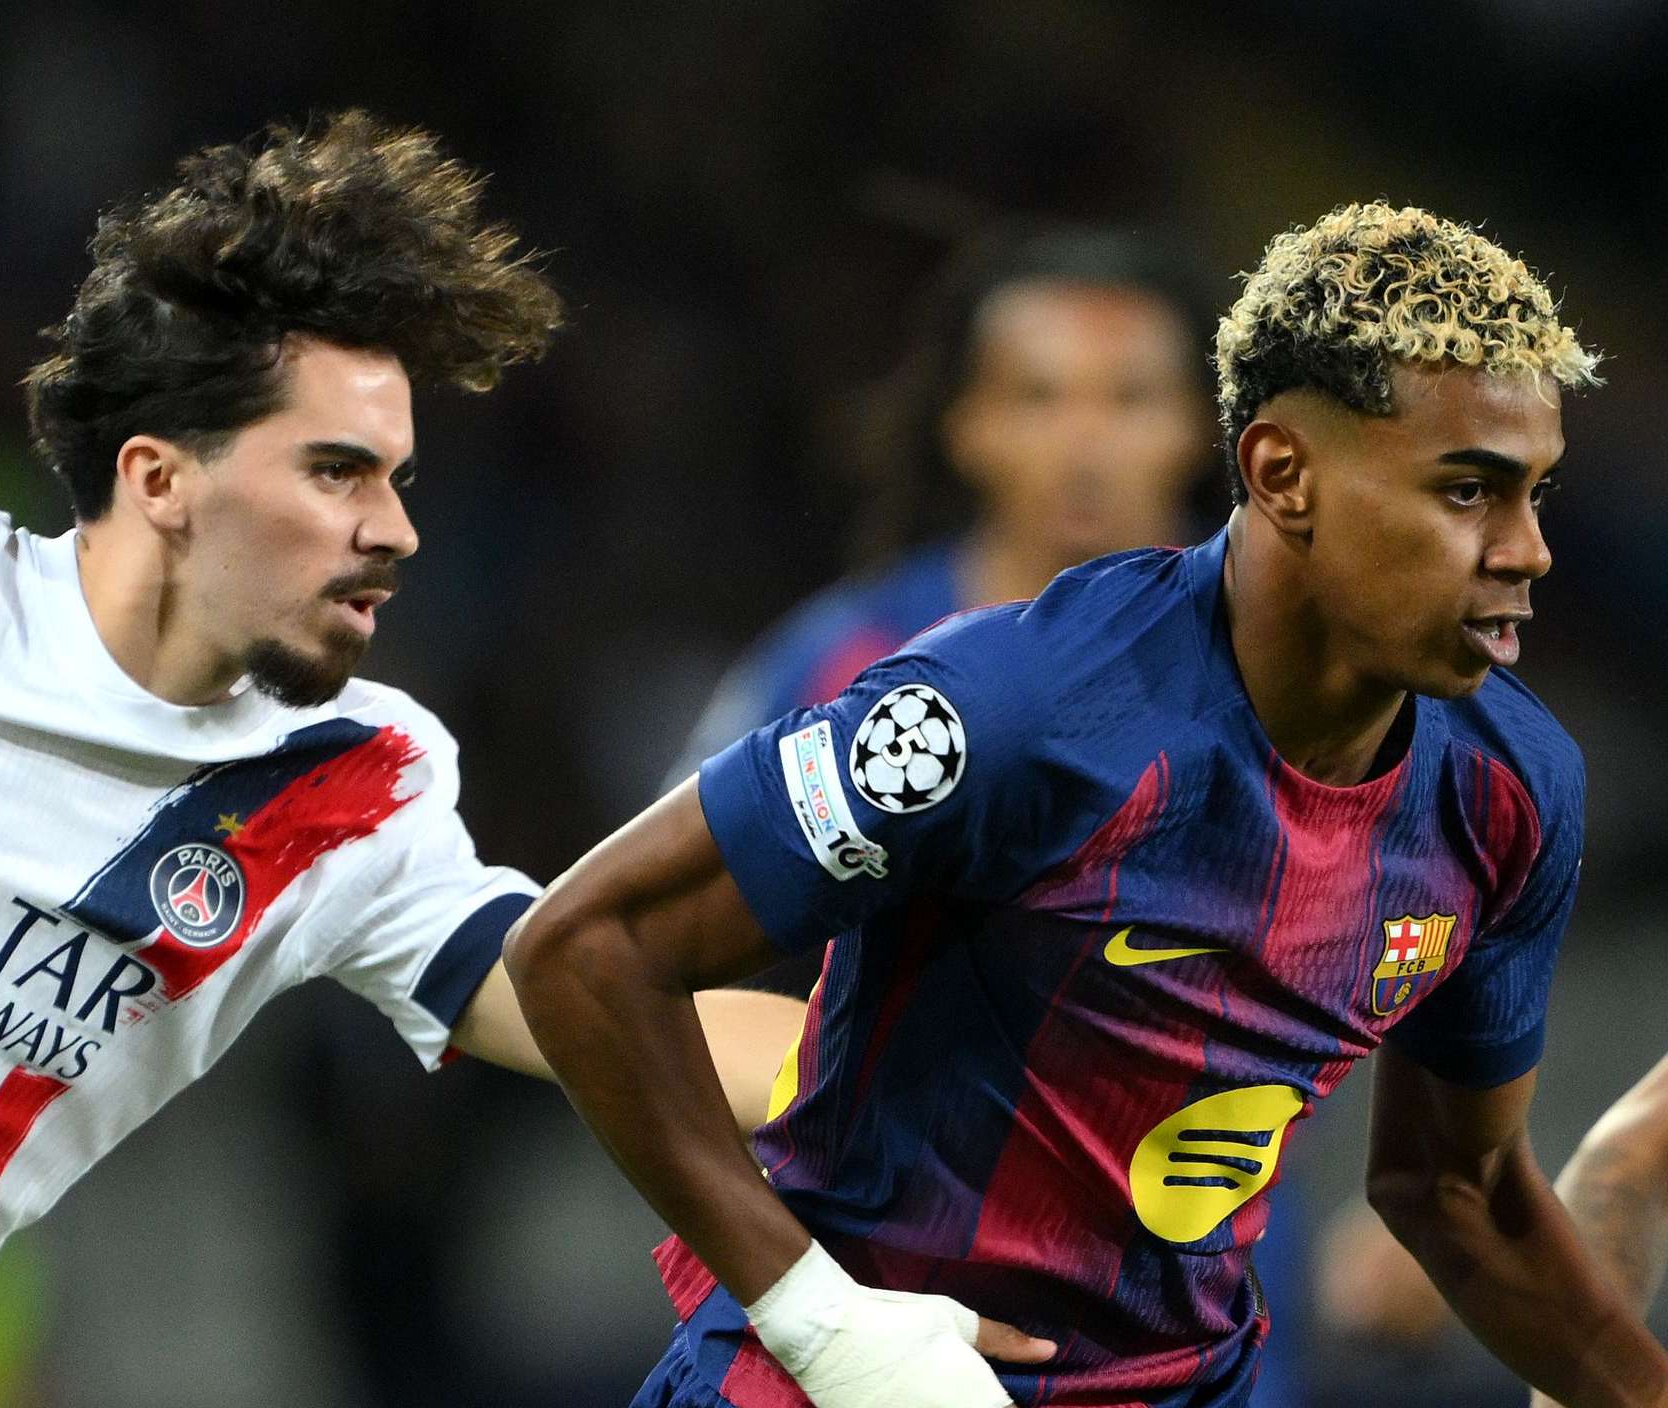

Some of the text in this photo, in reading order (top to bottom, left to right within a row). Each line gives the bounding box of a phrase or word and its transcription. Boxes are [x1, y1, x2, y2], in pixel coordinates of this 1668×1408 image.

[882, 726, 928, 768] 5
[177, 849, 236, 887] PARIS
[827, 830, 867, 869] 10
